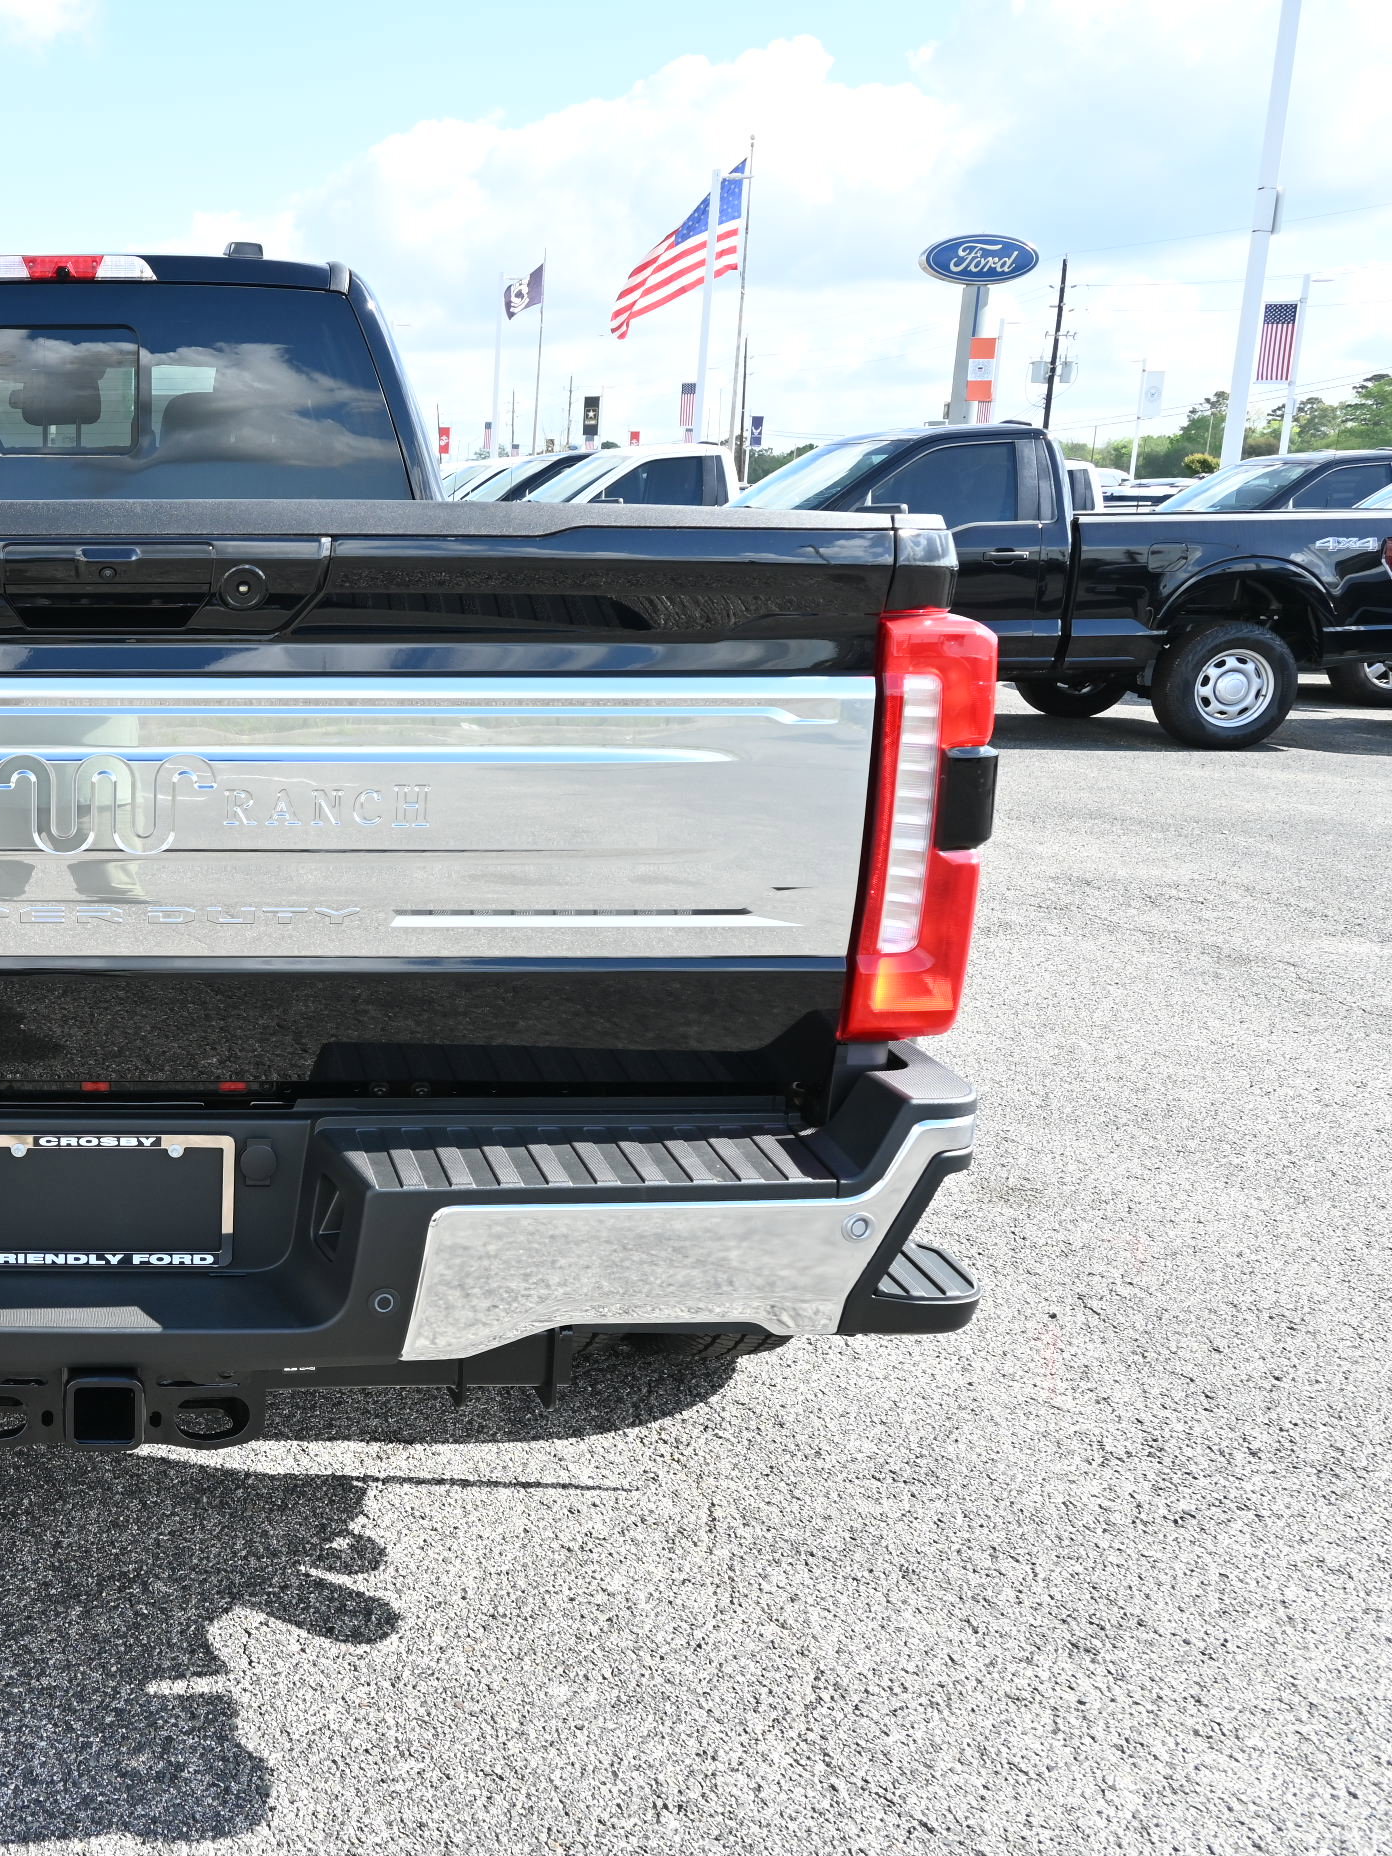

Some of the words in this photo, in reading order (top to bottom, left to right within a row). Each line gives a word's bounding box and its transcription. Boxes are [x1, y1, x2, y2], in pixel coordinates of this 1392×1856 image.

[950, 243, 1018, 272] Ford
[223, 783, 432, 827] RANCH
[147, 906, 361, 925] DUTY
[38, 1136, 157, 1147] CROSBY
[132, 1253, 215, 1266] FORD
